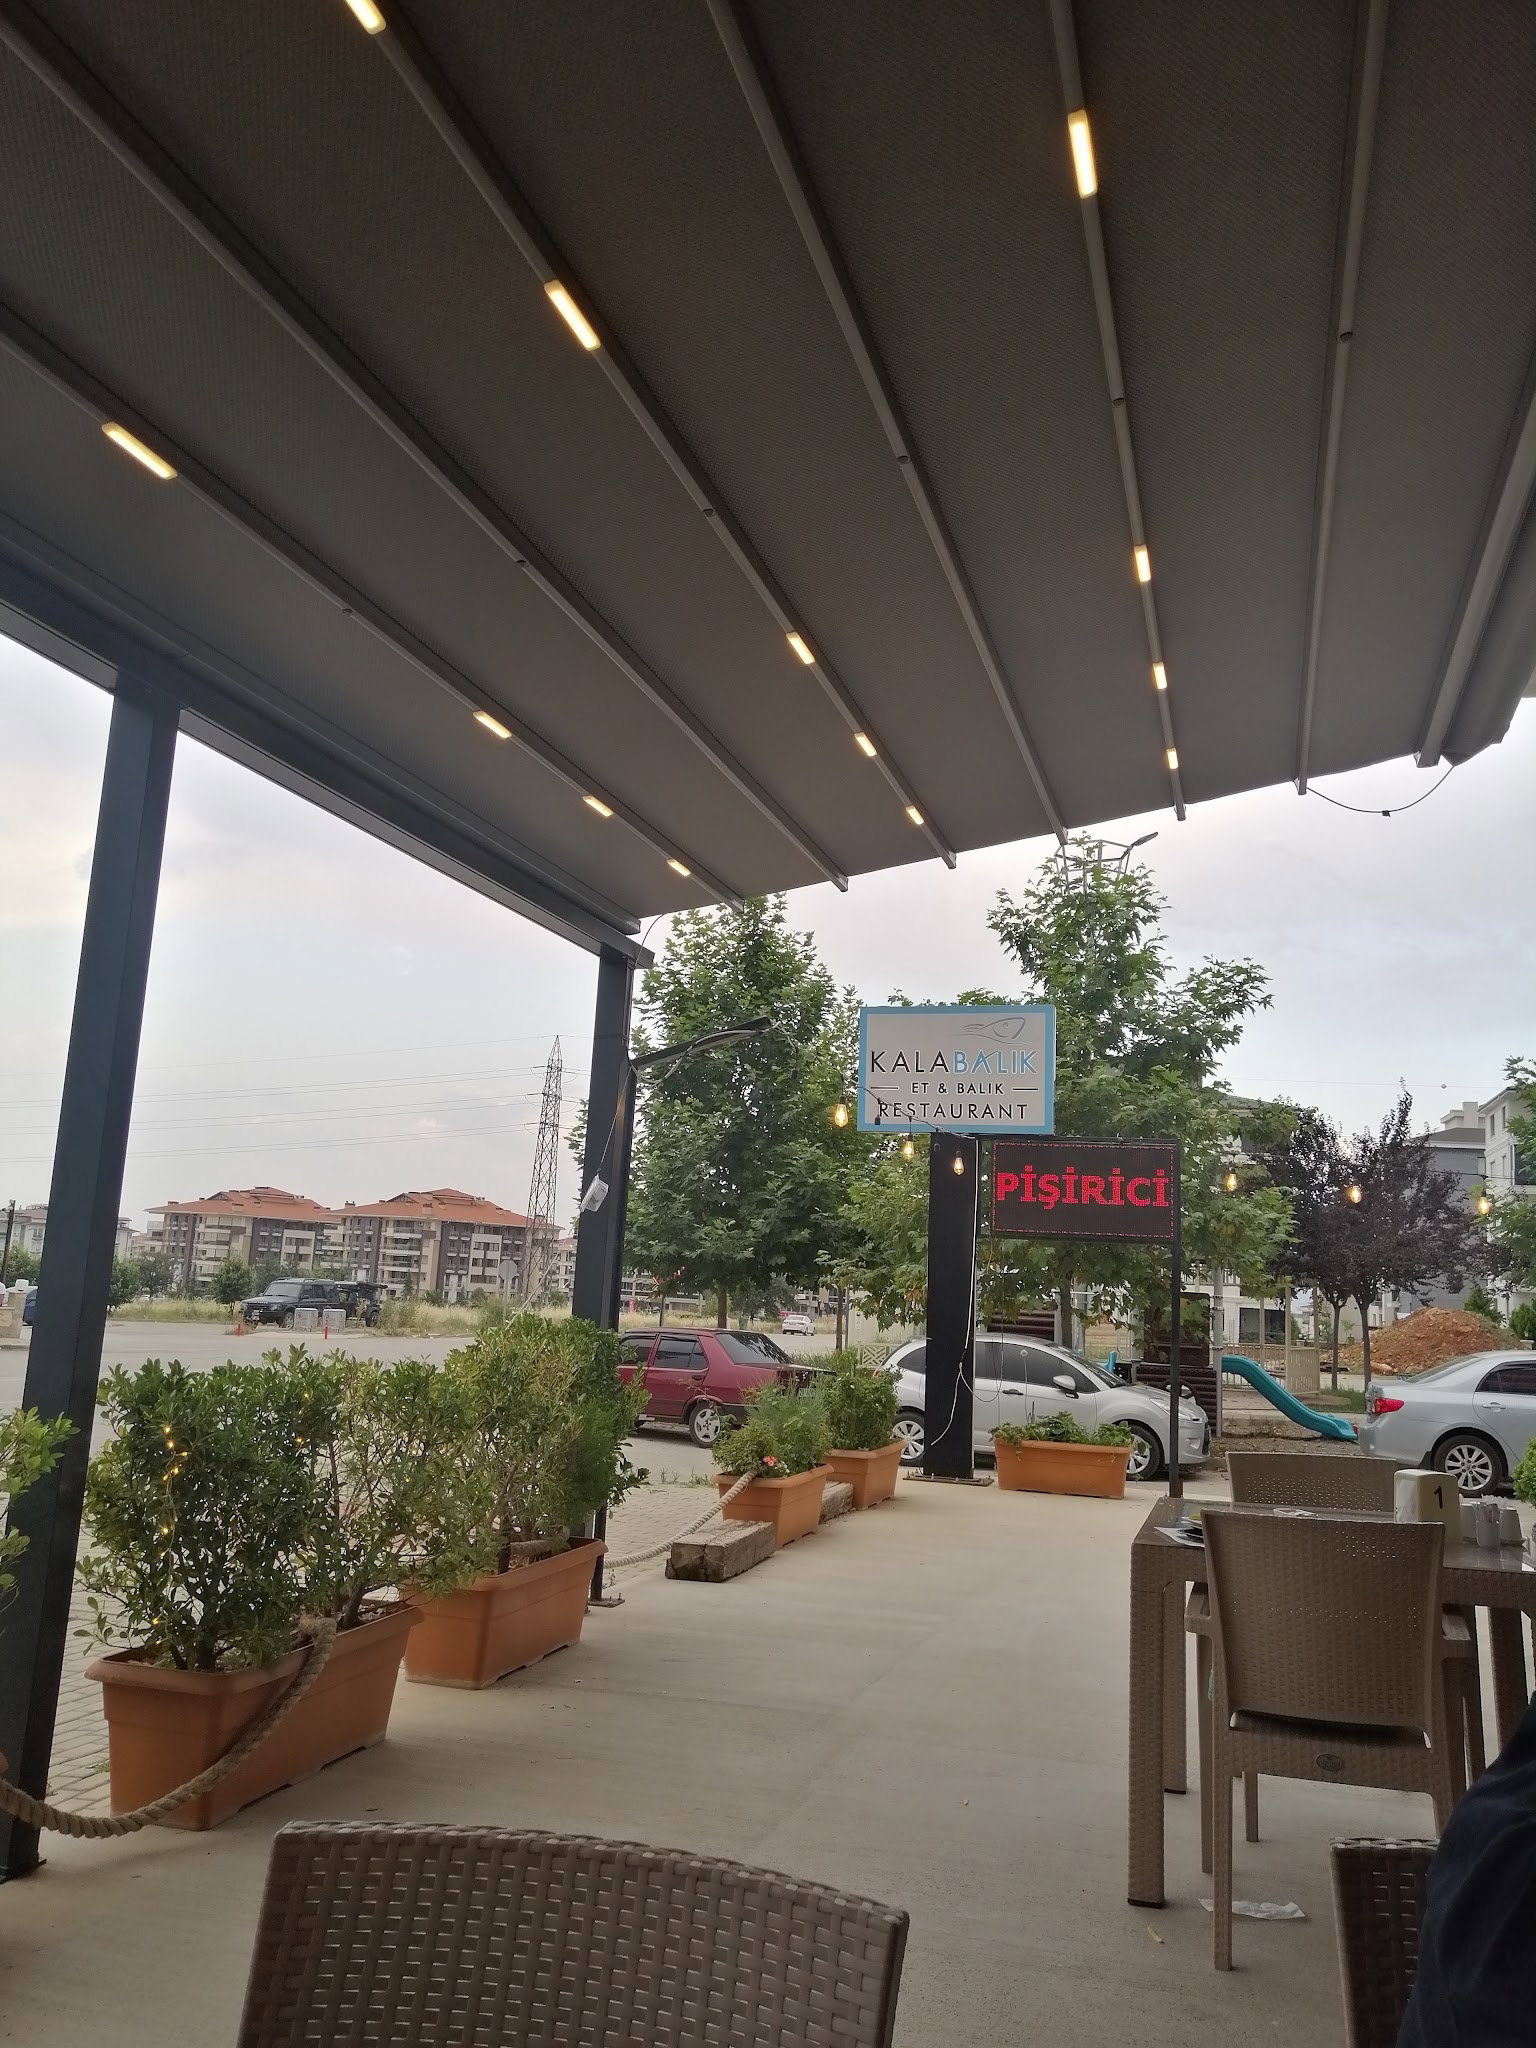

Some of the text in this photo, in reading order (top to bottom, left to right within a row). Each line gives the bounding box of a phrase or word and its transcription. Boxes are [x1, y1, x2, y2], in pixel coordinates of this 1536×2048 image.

[870, 1050, 1038, 1074] KALABALIK
[911, 1082, 1004, 1095] ET & BALIK
[878, 1102, 1028, 1119] RESTAURANT
[997, 1164, 1169, 1210] PİŞİRİCİ
[1433, 1485, 1443, 1509] 1
